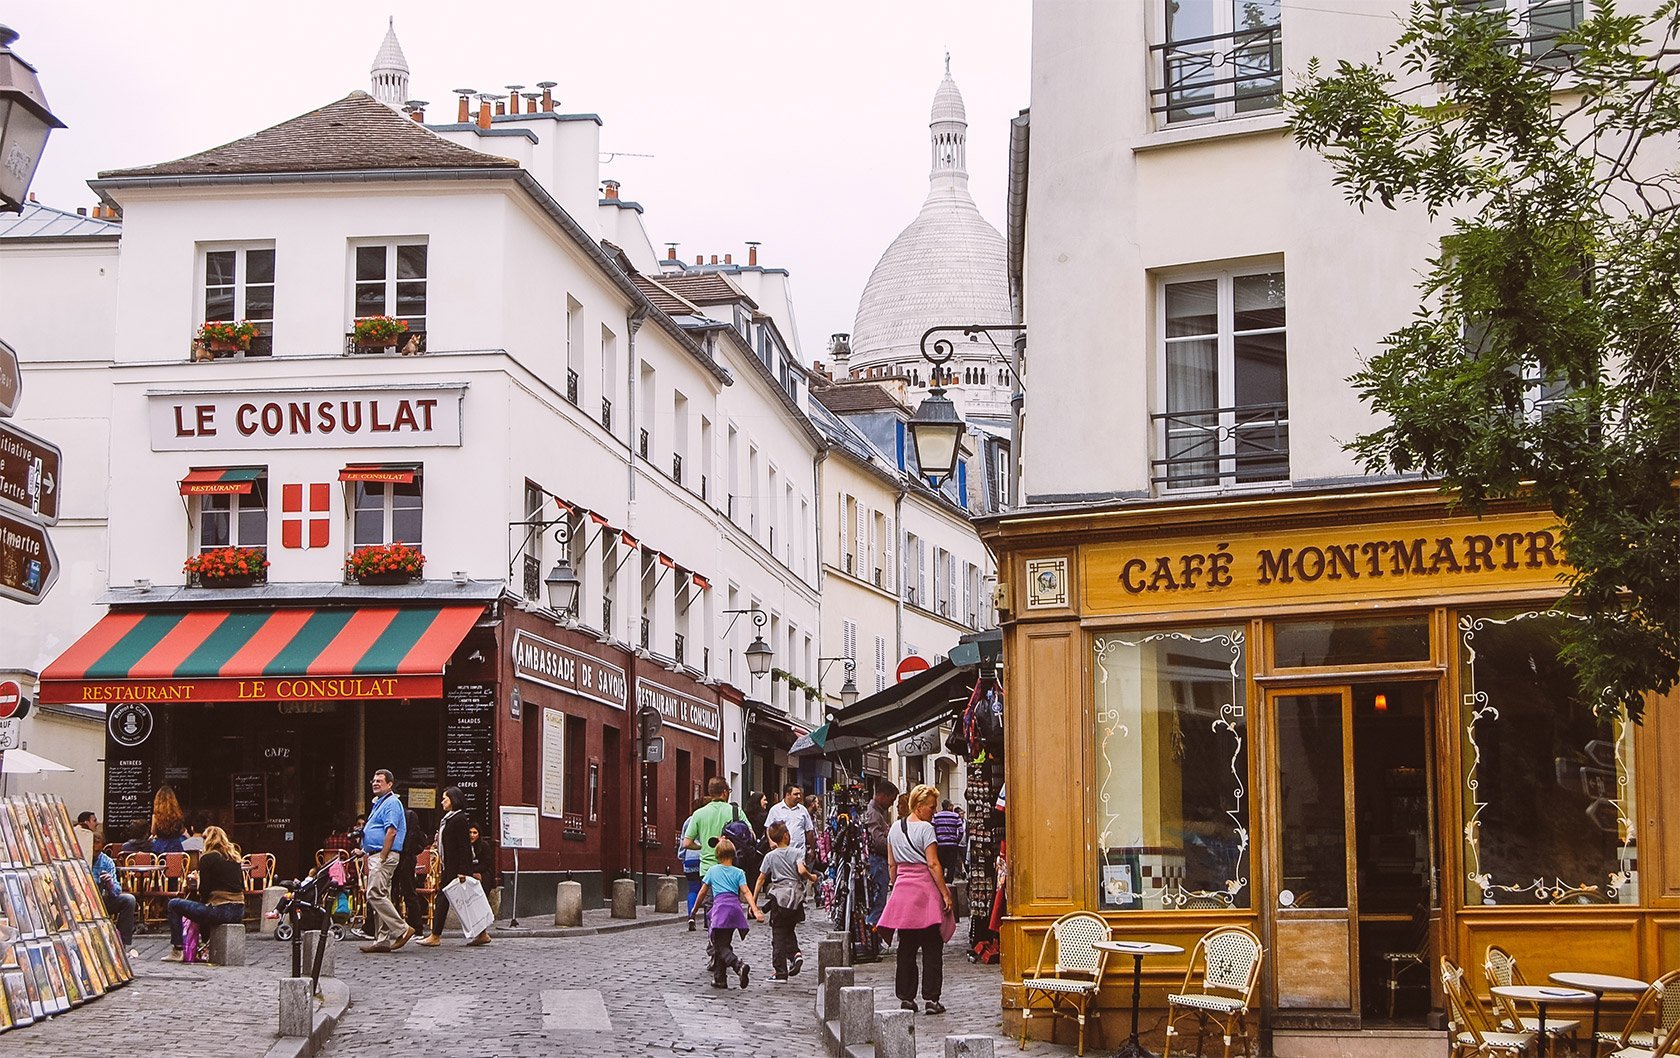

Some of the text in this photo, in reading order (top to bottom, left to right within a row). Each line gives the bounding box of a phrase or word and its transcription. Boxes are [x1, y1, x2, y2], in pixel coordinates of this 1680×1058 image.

[174, 399, 438, 437] LE CONSULAT
[190, 484, 241, 492] RESTAURANT
[1119, 530, 1569, 594] CAFÉ MONTMARTR
[82, 679, 398, 700] RESTAURANT LE CONSULAT
[518, 641, 624, 700] AMBASSADE DE SAVOIE
[637, 686, 717, 731] RESTAURANT LE CONSULAT
